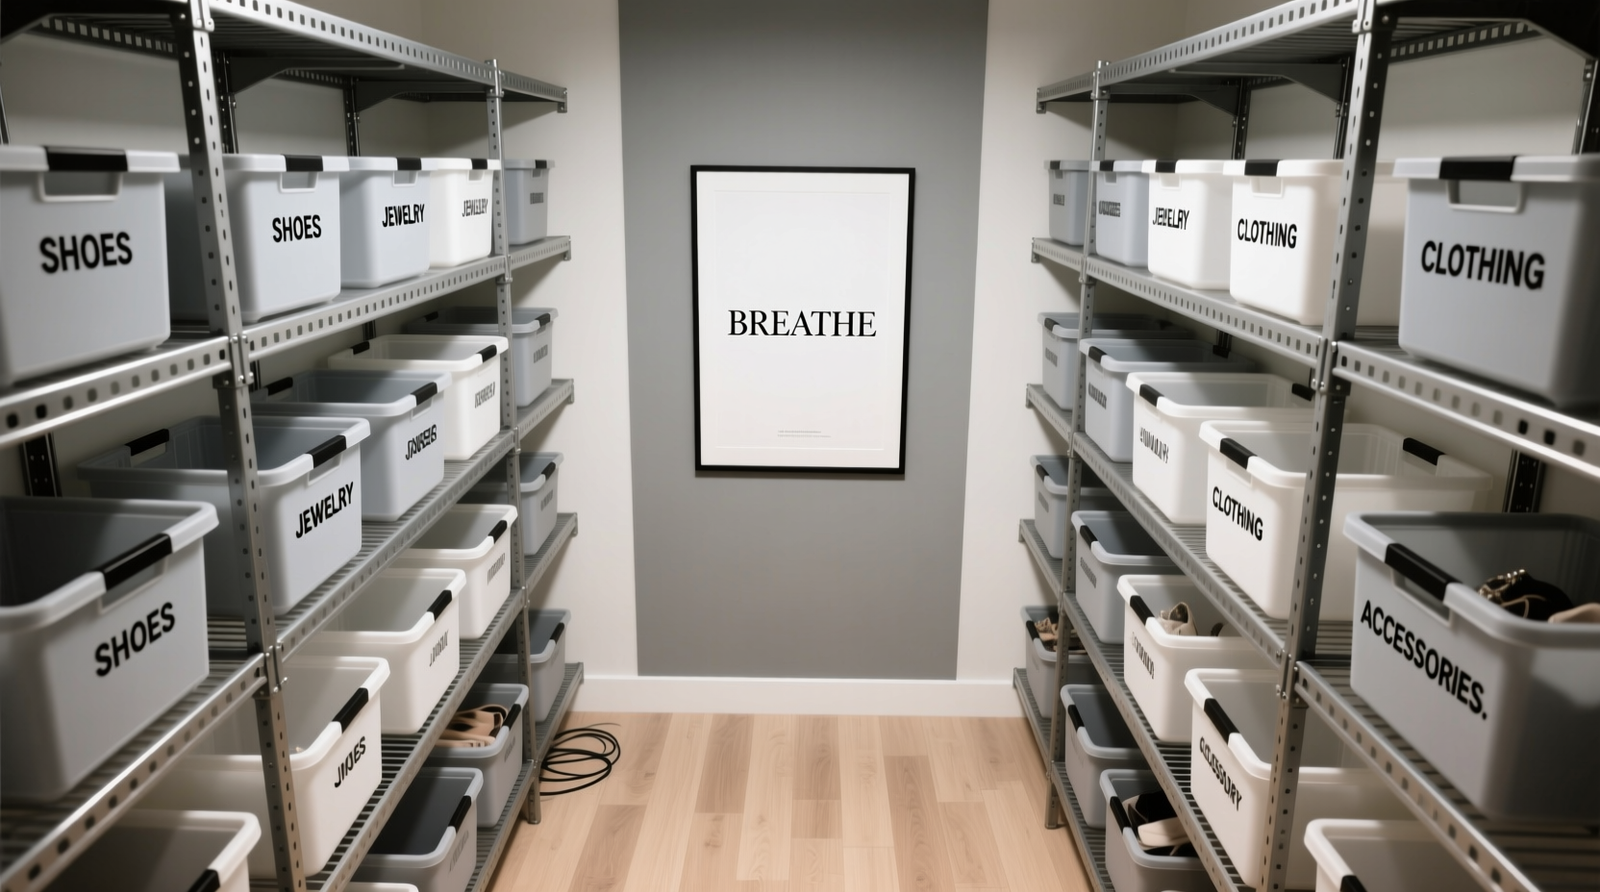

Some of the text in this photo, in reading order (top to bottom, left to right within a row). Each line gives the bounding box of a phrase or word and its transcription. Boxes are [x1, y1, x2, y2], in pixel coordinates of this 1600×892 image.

[271, 214, 322, 242] SHOES
[382, 203, 425, 227] JEWELRY
[1237, 217, 1298, 249] CLOTHING
[39, 231, 133, 274] SHOES
[1420, 240, 1545, 290] CLOTHING
[728, 309, 877, 337] BREATHE
[295, 481, 354, 538] JEWELRY
[1212, 485, 1264, 541] CLOTHING
[94, 602, 176, 677] SHOES
[1359, 599, 1488, 721] ACCESSORIES.
